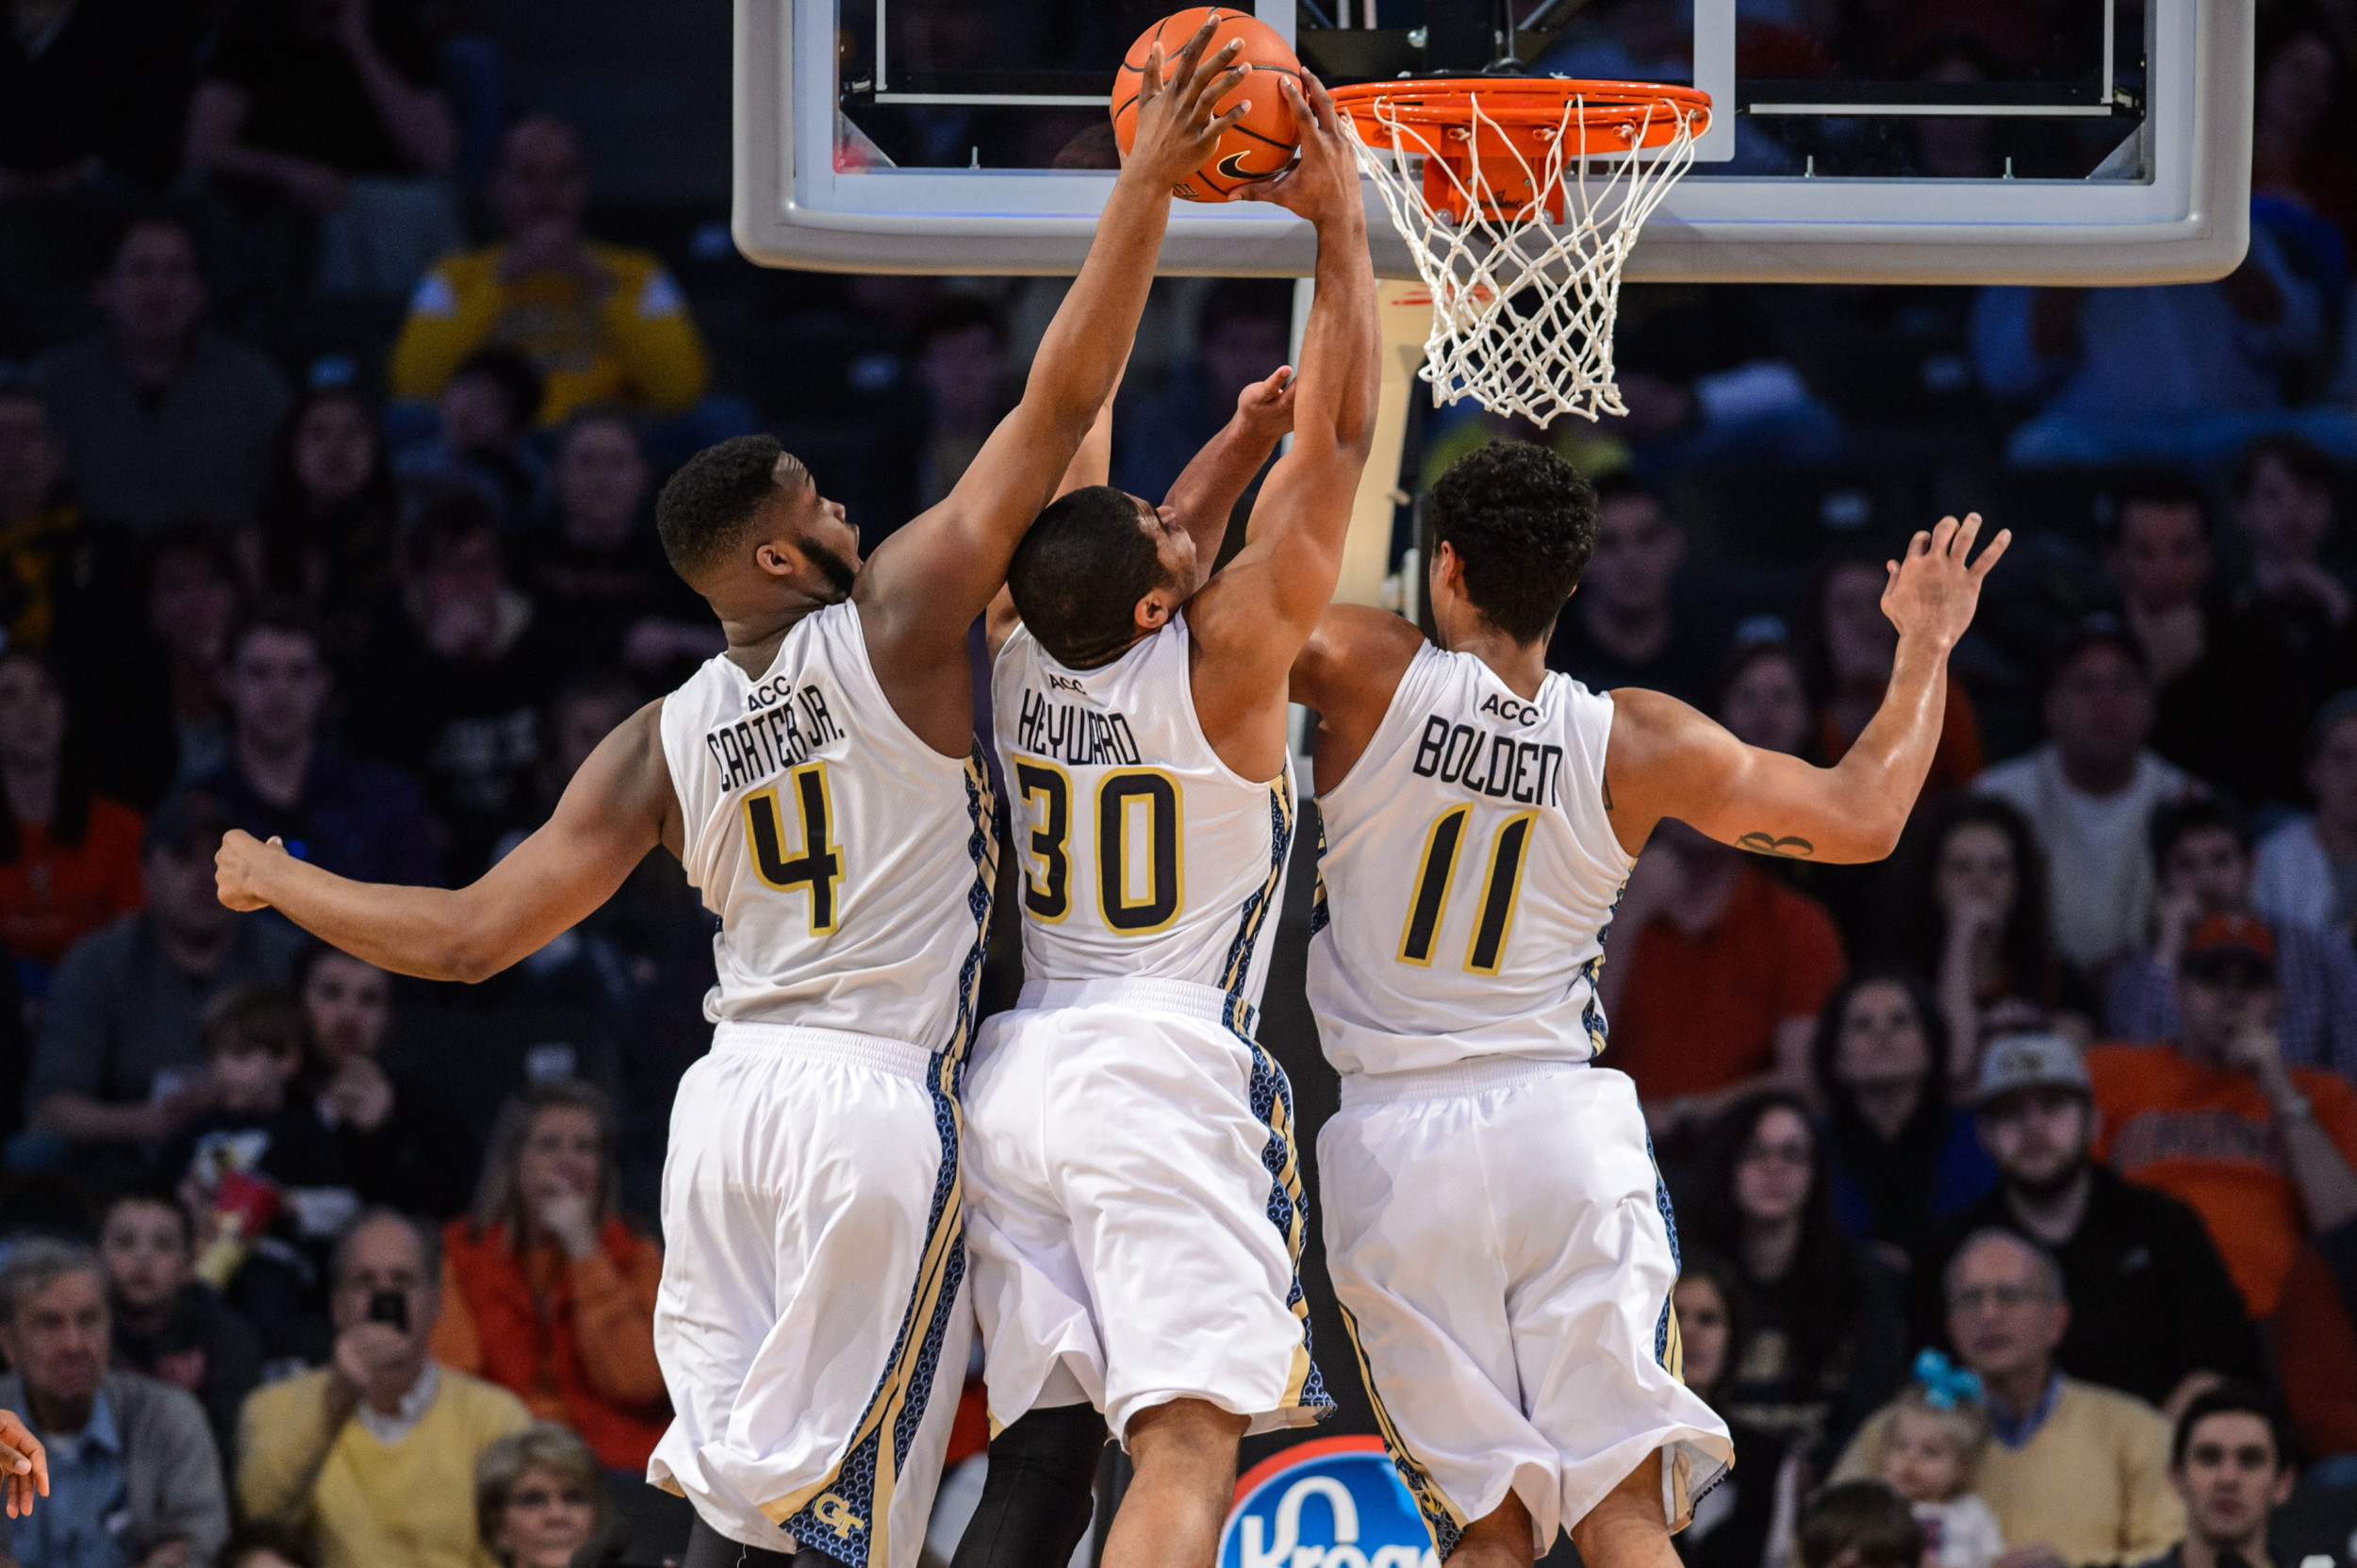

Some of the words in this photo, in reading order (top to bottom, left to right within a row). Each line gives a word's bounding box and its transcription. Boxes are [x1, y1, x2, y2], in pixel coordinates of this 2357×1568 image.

[746, 675, 792, 712] ACC
[1018, 688, 1142, 766] HEYWARD
[1048, 674, 1087, 696] ACC
[1480, 694, 1540, 727] ACC
[707, 701, 807, 792] CARTER
[797, 685, 846, 748] JR.
[1412, 715, 1563, 807] BOLDEN
[741, 761, 846, 937] 4
[1014, 753, 1185, 936] 30
[1395, 801, 1540, 977] 11
[814, 1493, 865, 1539] GT
